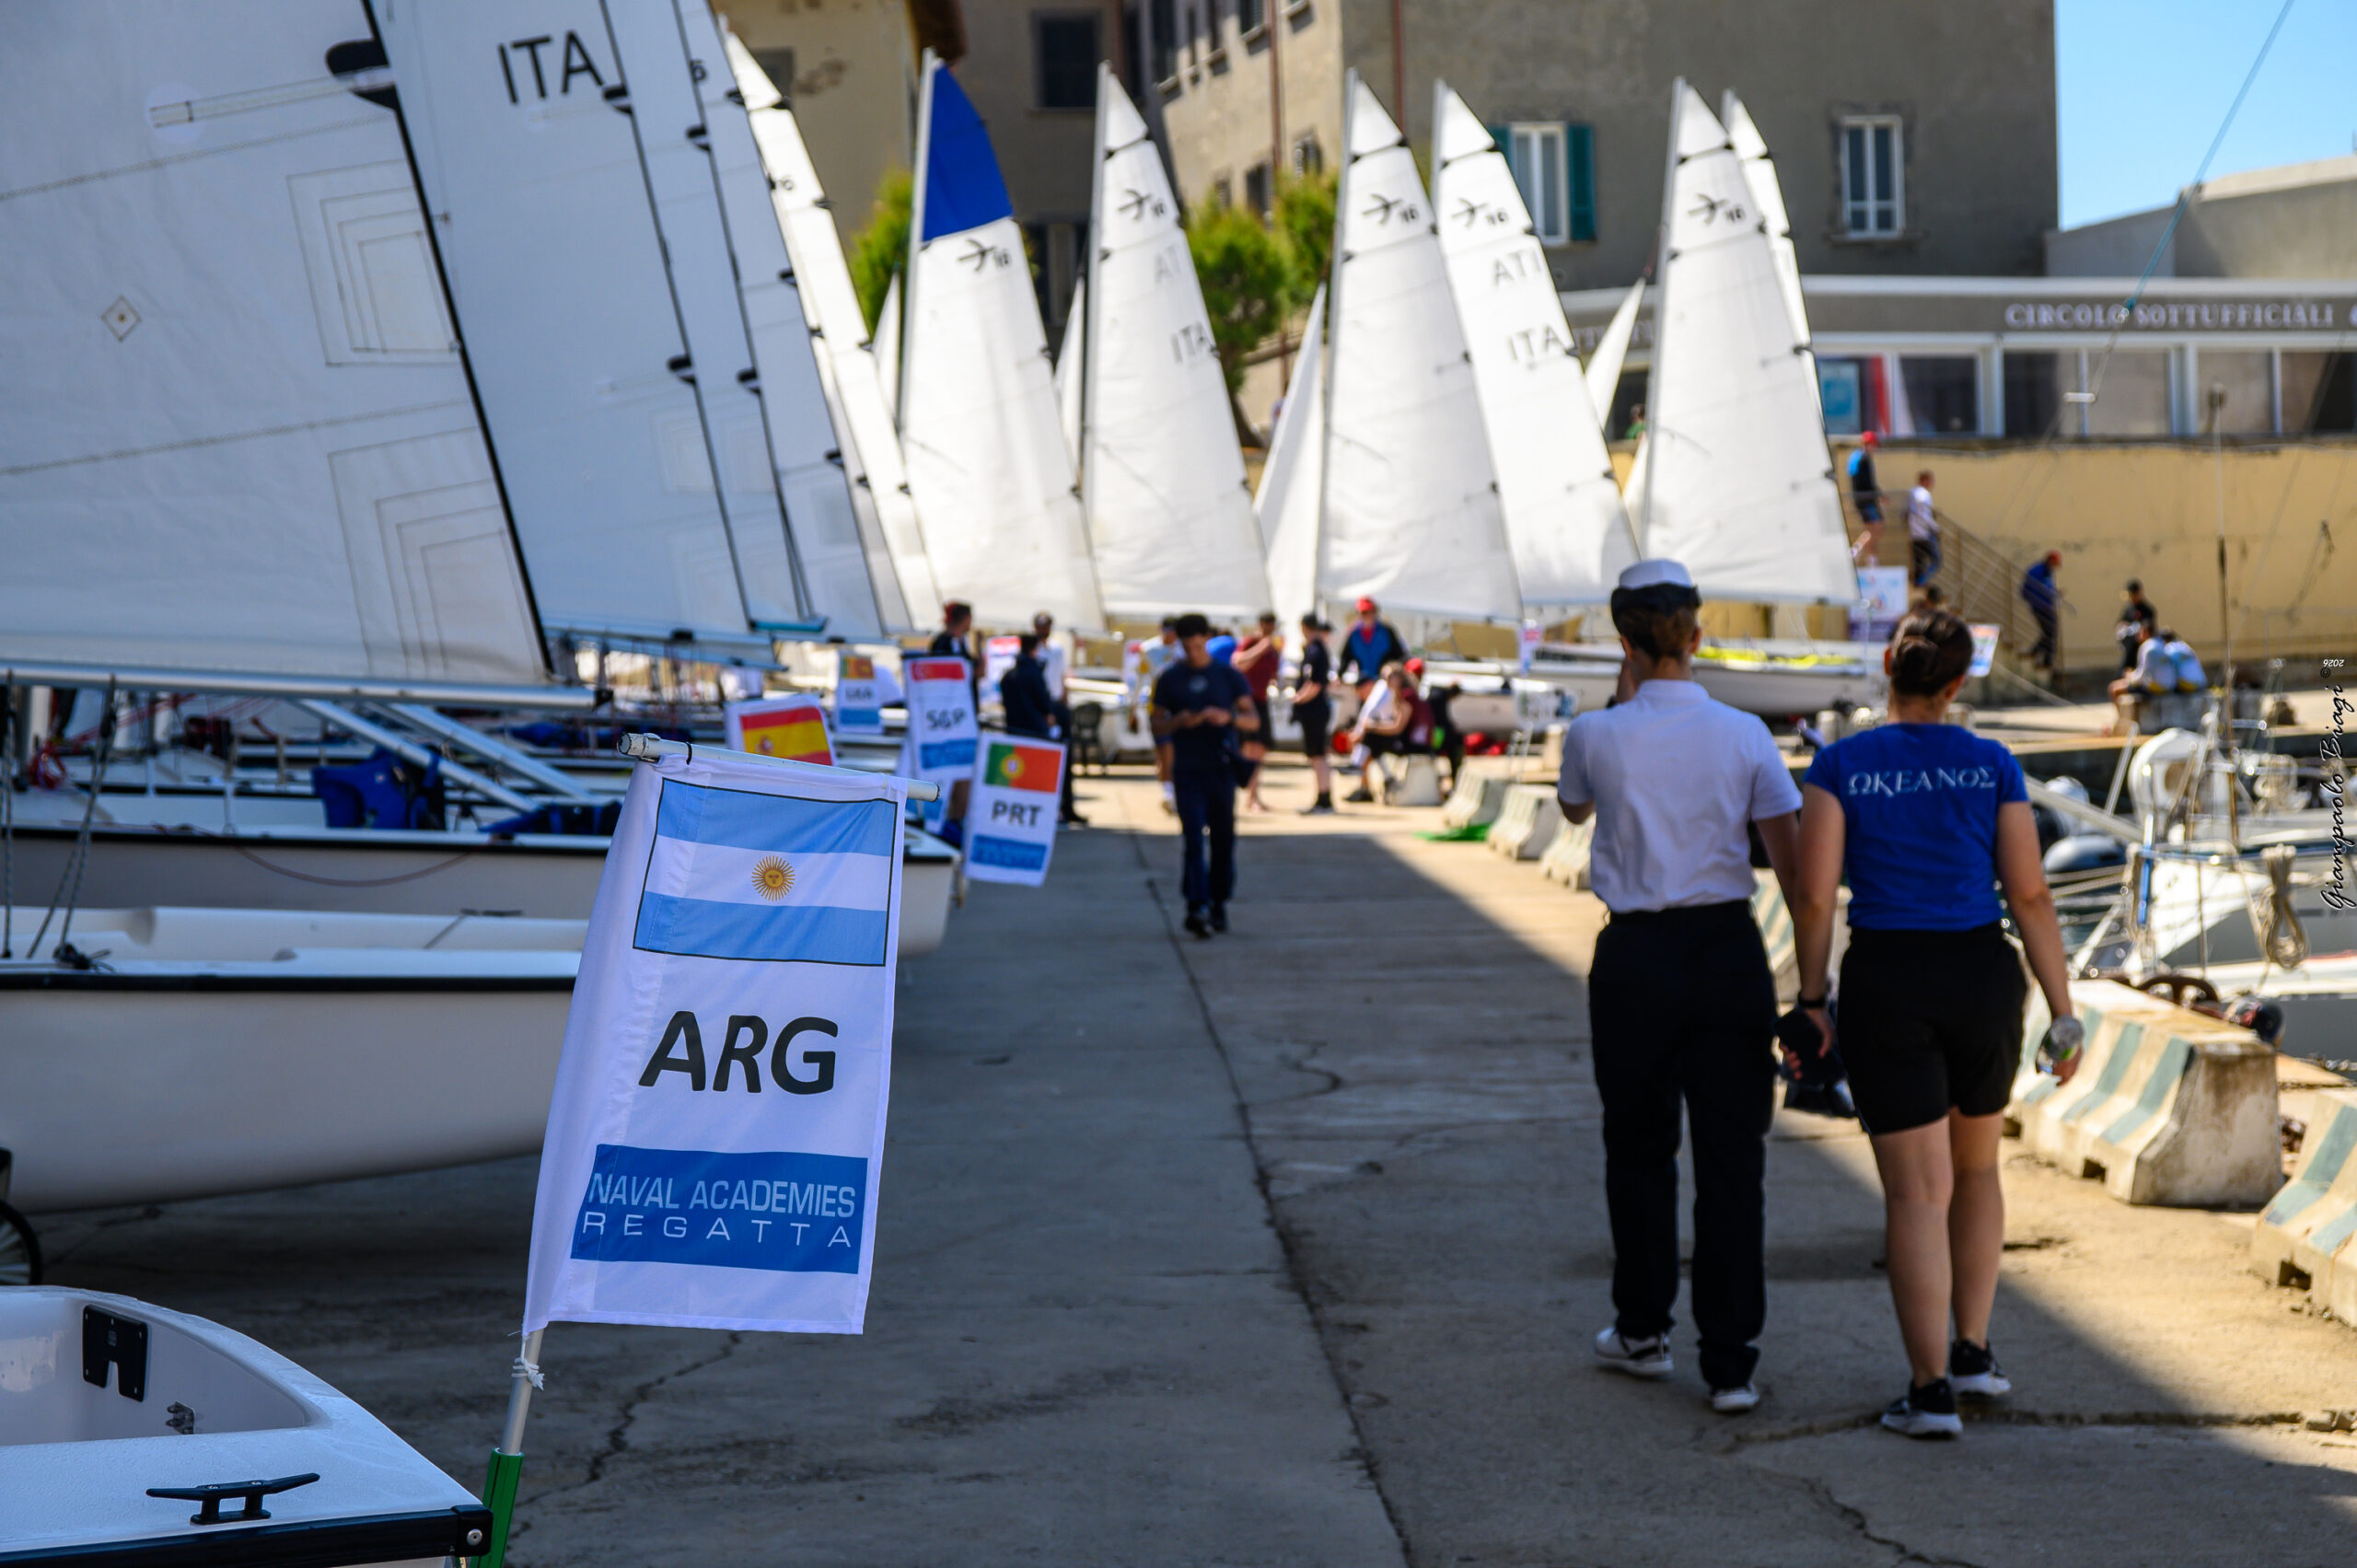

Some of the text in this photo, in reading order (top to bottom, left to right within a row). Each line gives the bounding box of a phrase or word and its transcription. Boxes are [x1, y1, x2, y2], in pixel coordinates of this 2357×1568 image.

[497, 31, 604, 104] ITA
[2004, 302, 2129, 329] CIRCOLO
[2134, 303, 2335, 329] SOTTUFFICIALI
[1506, 325, 1566, 361] ITA
[926, 707, 966, 730] SGP
[991, 799, 1042, 826] PRT
[638, 1010, 839, 1095] ARG
[587, 1172, 856, 1218] NAVAL ACADEMIES
[582, 1211, 852, 1248] REGATTA
